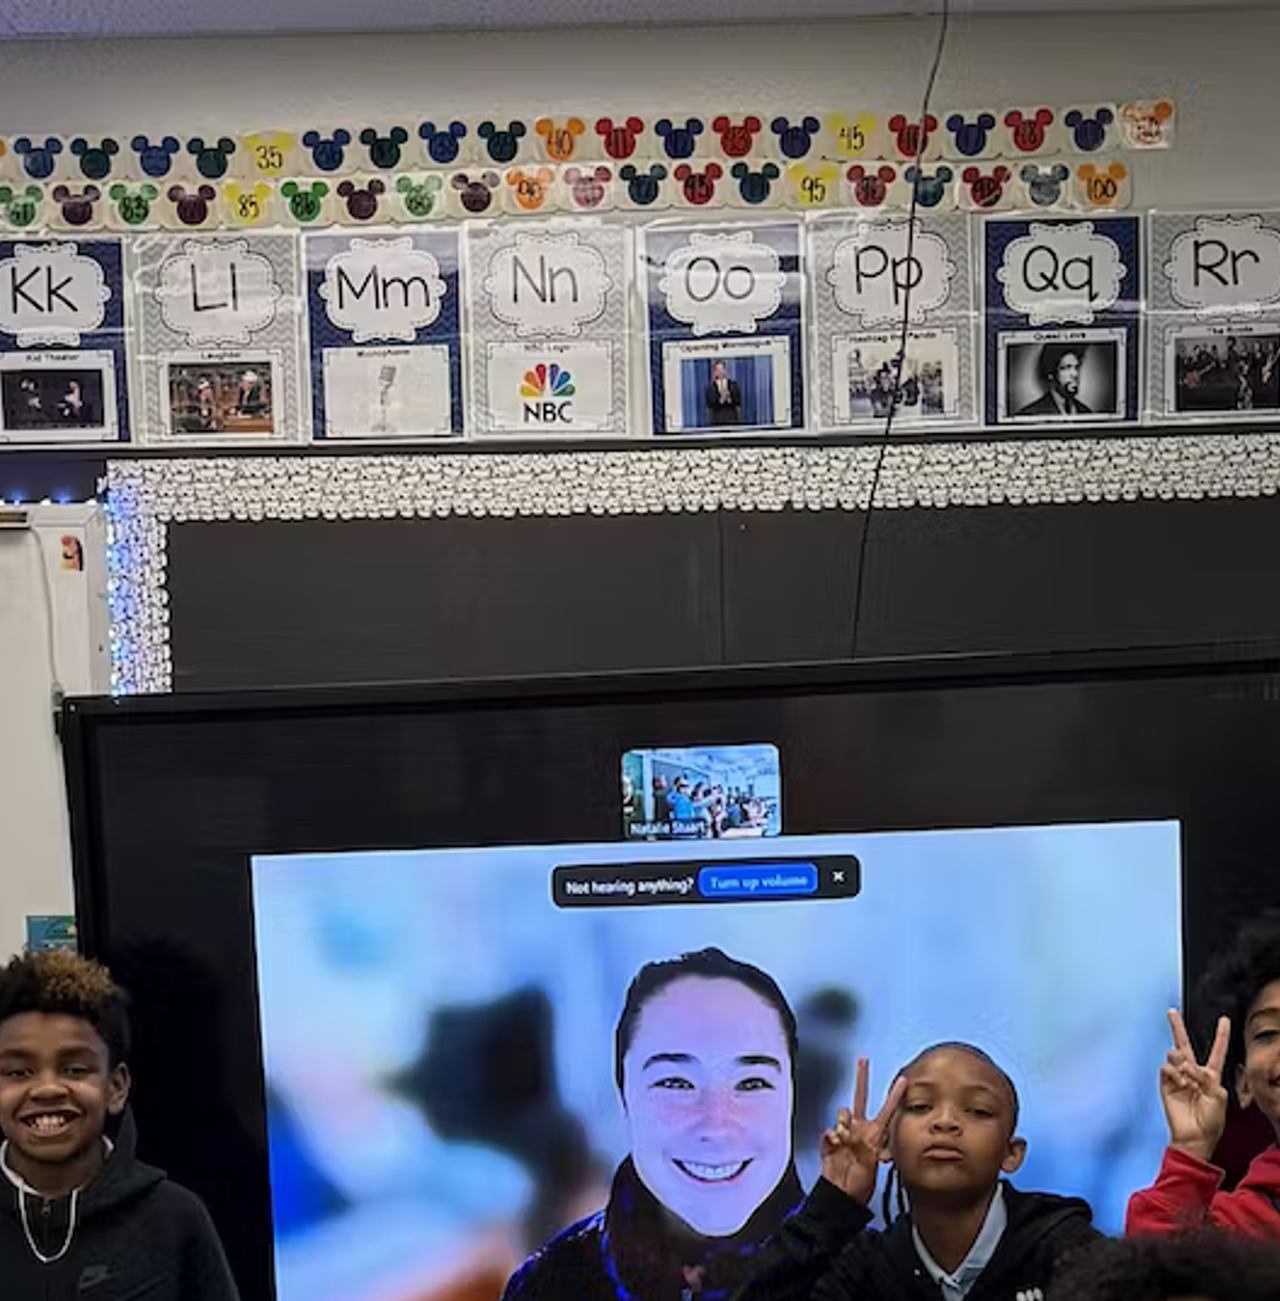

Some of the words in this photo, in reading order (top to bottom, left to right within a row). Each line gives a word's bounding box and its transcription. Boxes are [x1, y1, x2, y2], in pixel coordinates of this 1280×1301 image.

[839, 125, 865, 150] 45
[256, 146, 283, 170] 35
[800, 176, 826, 203] 95
[1087, 176, 1117, 199] 100
[237, 194, 261, 218] 85
[511, 254, 579, 304] Nn
[685, 256, 756, 302] Oo
[855, 244, 923, 305] Pp
[1023, 245, 1099, 302] Qq
[1192, 239, 1261, 287] Rr
[10, 265, 79, 314] Kk
[190, 262, 239, 313] Ll
[336, 264, 431, 310] Mm
[523, 401, 574, 424] NBC
[565, 881, 590, 896] Not
[591, 880, 636, 897] hearing
[637, 877, 694, 896] anything?
[710, 877, 739, 889] Turn
[742, 877, 760, 891] up
[761, 875, 809, 888] volume
